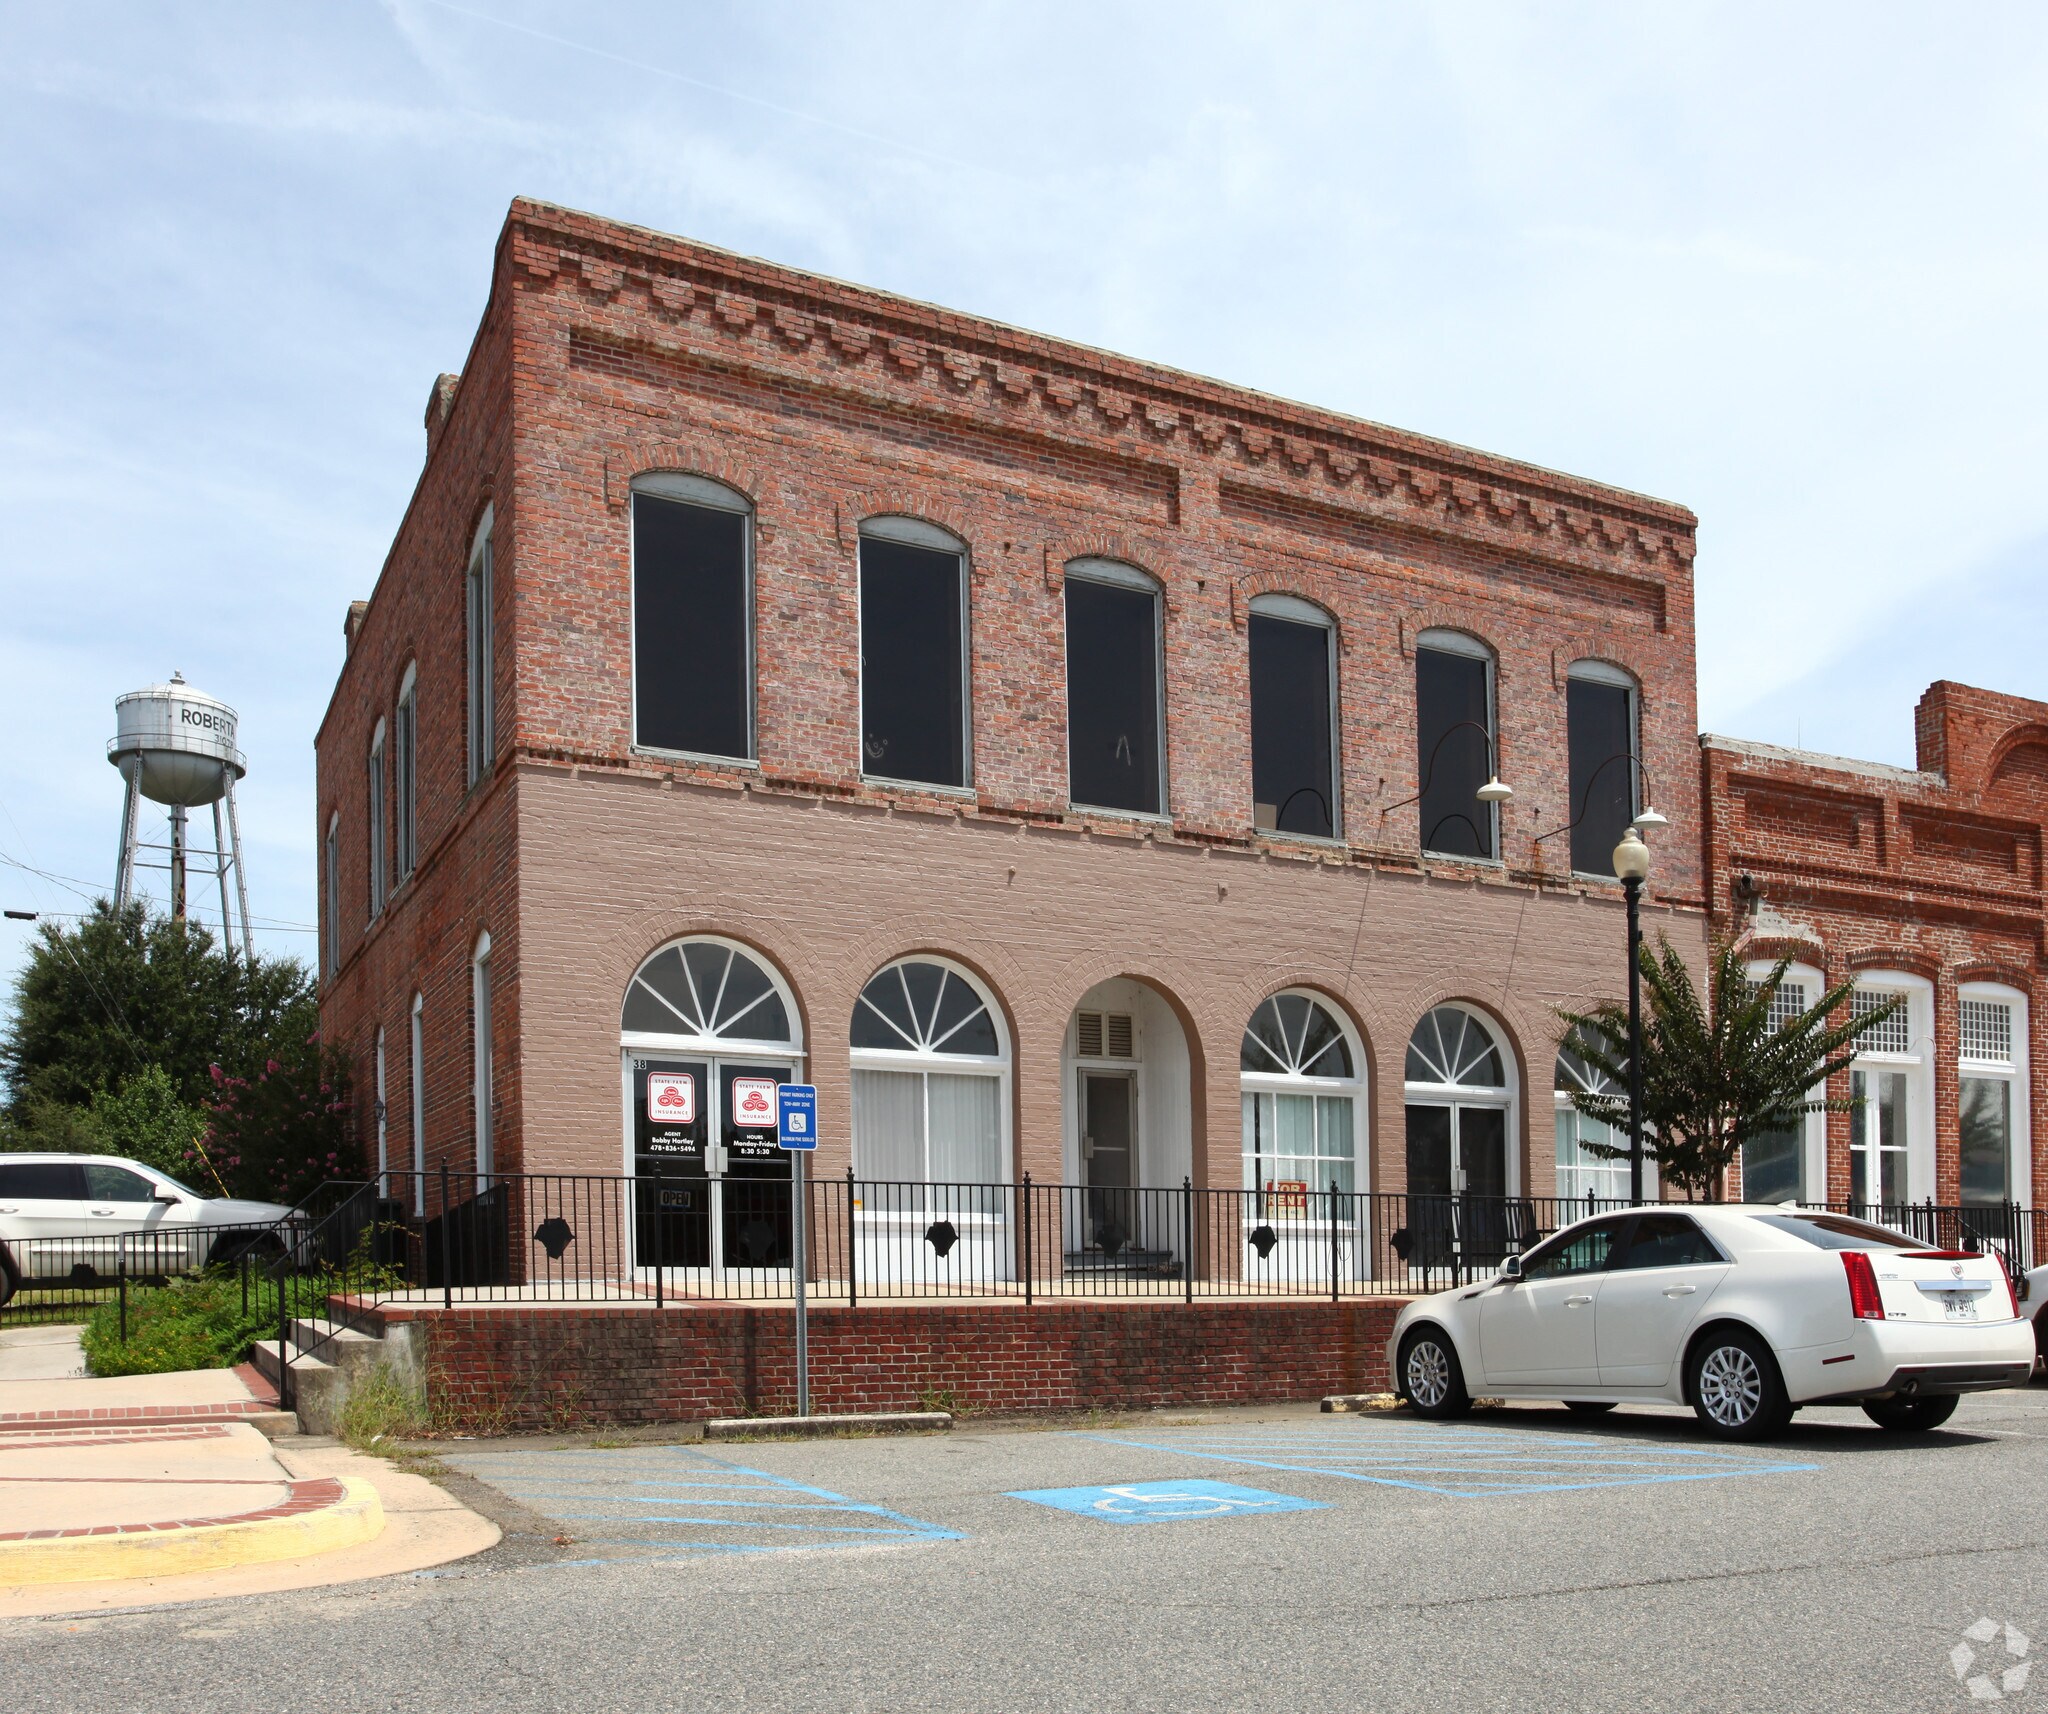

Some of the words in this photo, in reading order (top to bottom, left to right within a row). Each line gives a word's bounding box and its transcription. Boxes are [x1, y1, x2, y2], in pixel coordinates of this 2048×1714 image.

[181, 708, 235, 739] ROBERTA
[633, 1060, 646, 1069] 38
[651, 1137, 671, 1145] Bobby
[733, 1140, 777, 1148] Monday-Friday
[663, 1191, 689, 1205] OPEN
[1267, 1195, 1305, 1206] RENT
